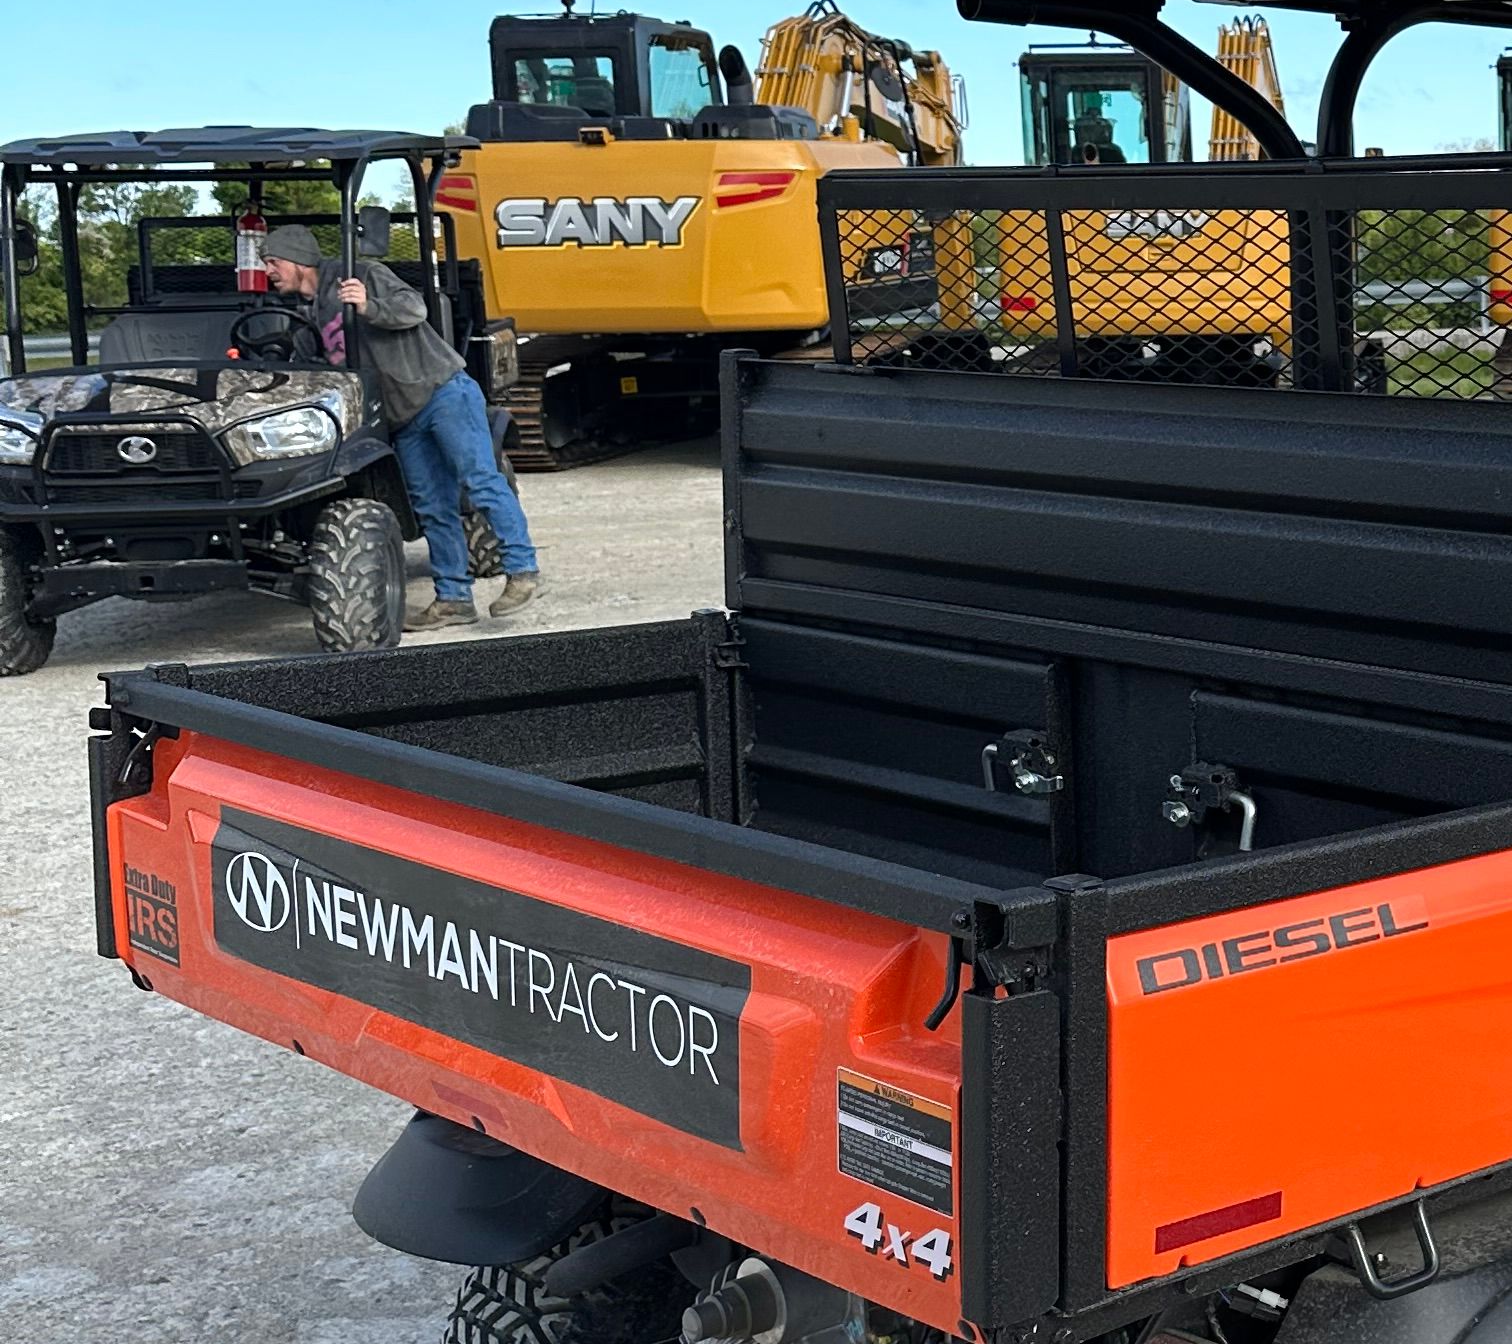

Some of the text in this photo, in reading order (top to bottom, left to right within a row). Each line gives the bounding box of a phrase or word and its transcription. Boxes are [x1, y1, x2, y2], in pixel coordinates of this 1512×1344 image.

[495, 196, 703, 248] SANY
[127, 893, 178, 948] IRS
[1136, 903, 1429, 996] DIESEL
[881, 1086, 915, 1107] WARNING
[873, 1127, 914, 1150] IMPORTANT
[843, 1201, 955, 1283] 4x4
